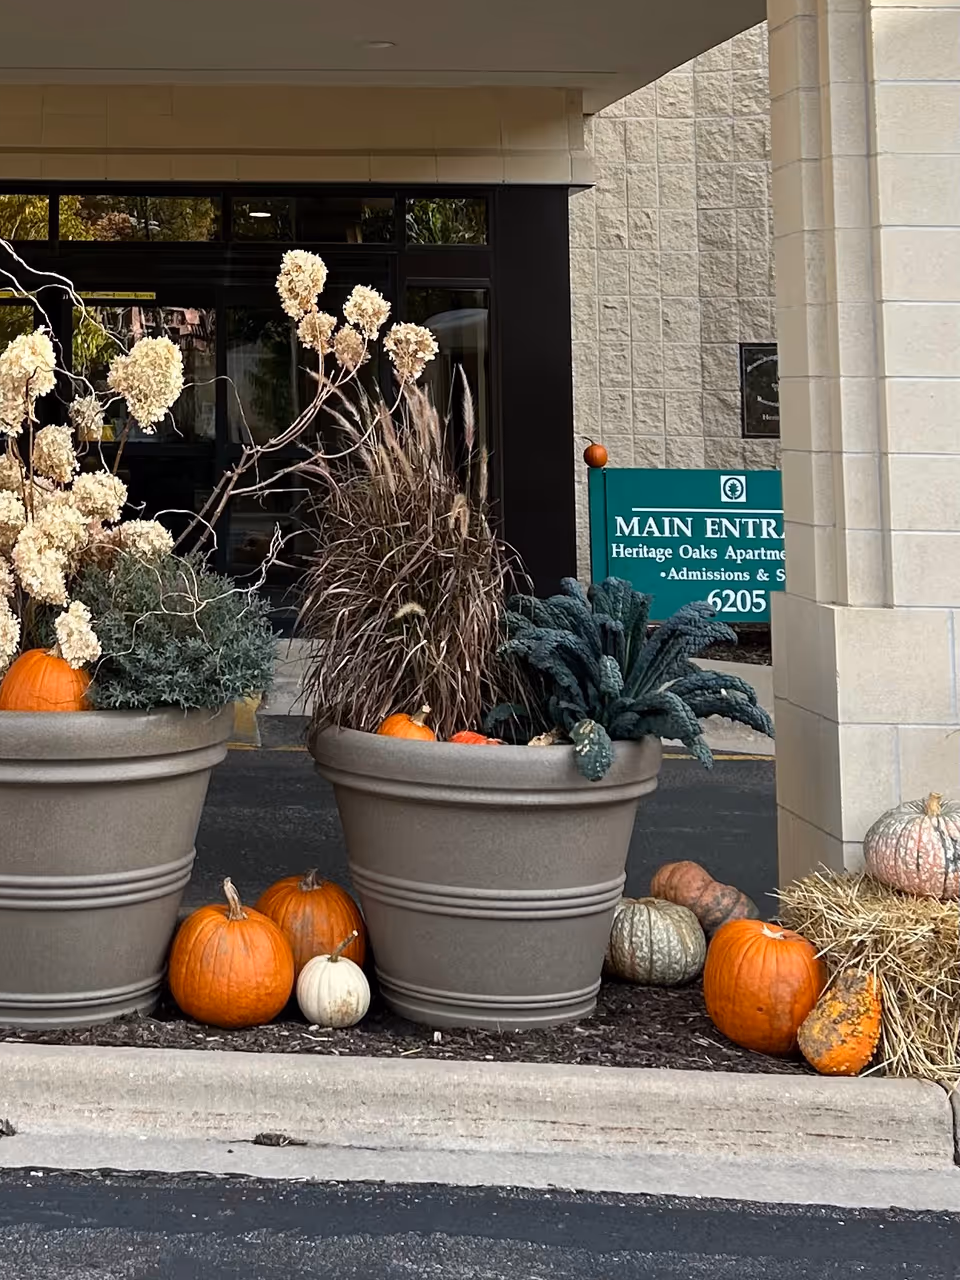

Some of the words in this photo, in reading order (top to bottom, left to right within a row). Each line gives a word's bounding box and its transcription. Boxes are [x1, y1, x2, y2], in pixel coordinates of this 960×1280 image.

[614, 515, 693, 537] MAIN
[704, 517, 785, 539] ENTR
[611, 543, 673, 563] Heritage
[678, 544, 718, 559] Oaks
[724, 545, 786, 564] Apartme
[756, 568, 770, 581] &
[707, 589, 767, 613] 6205
